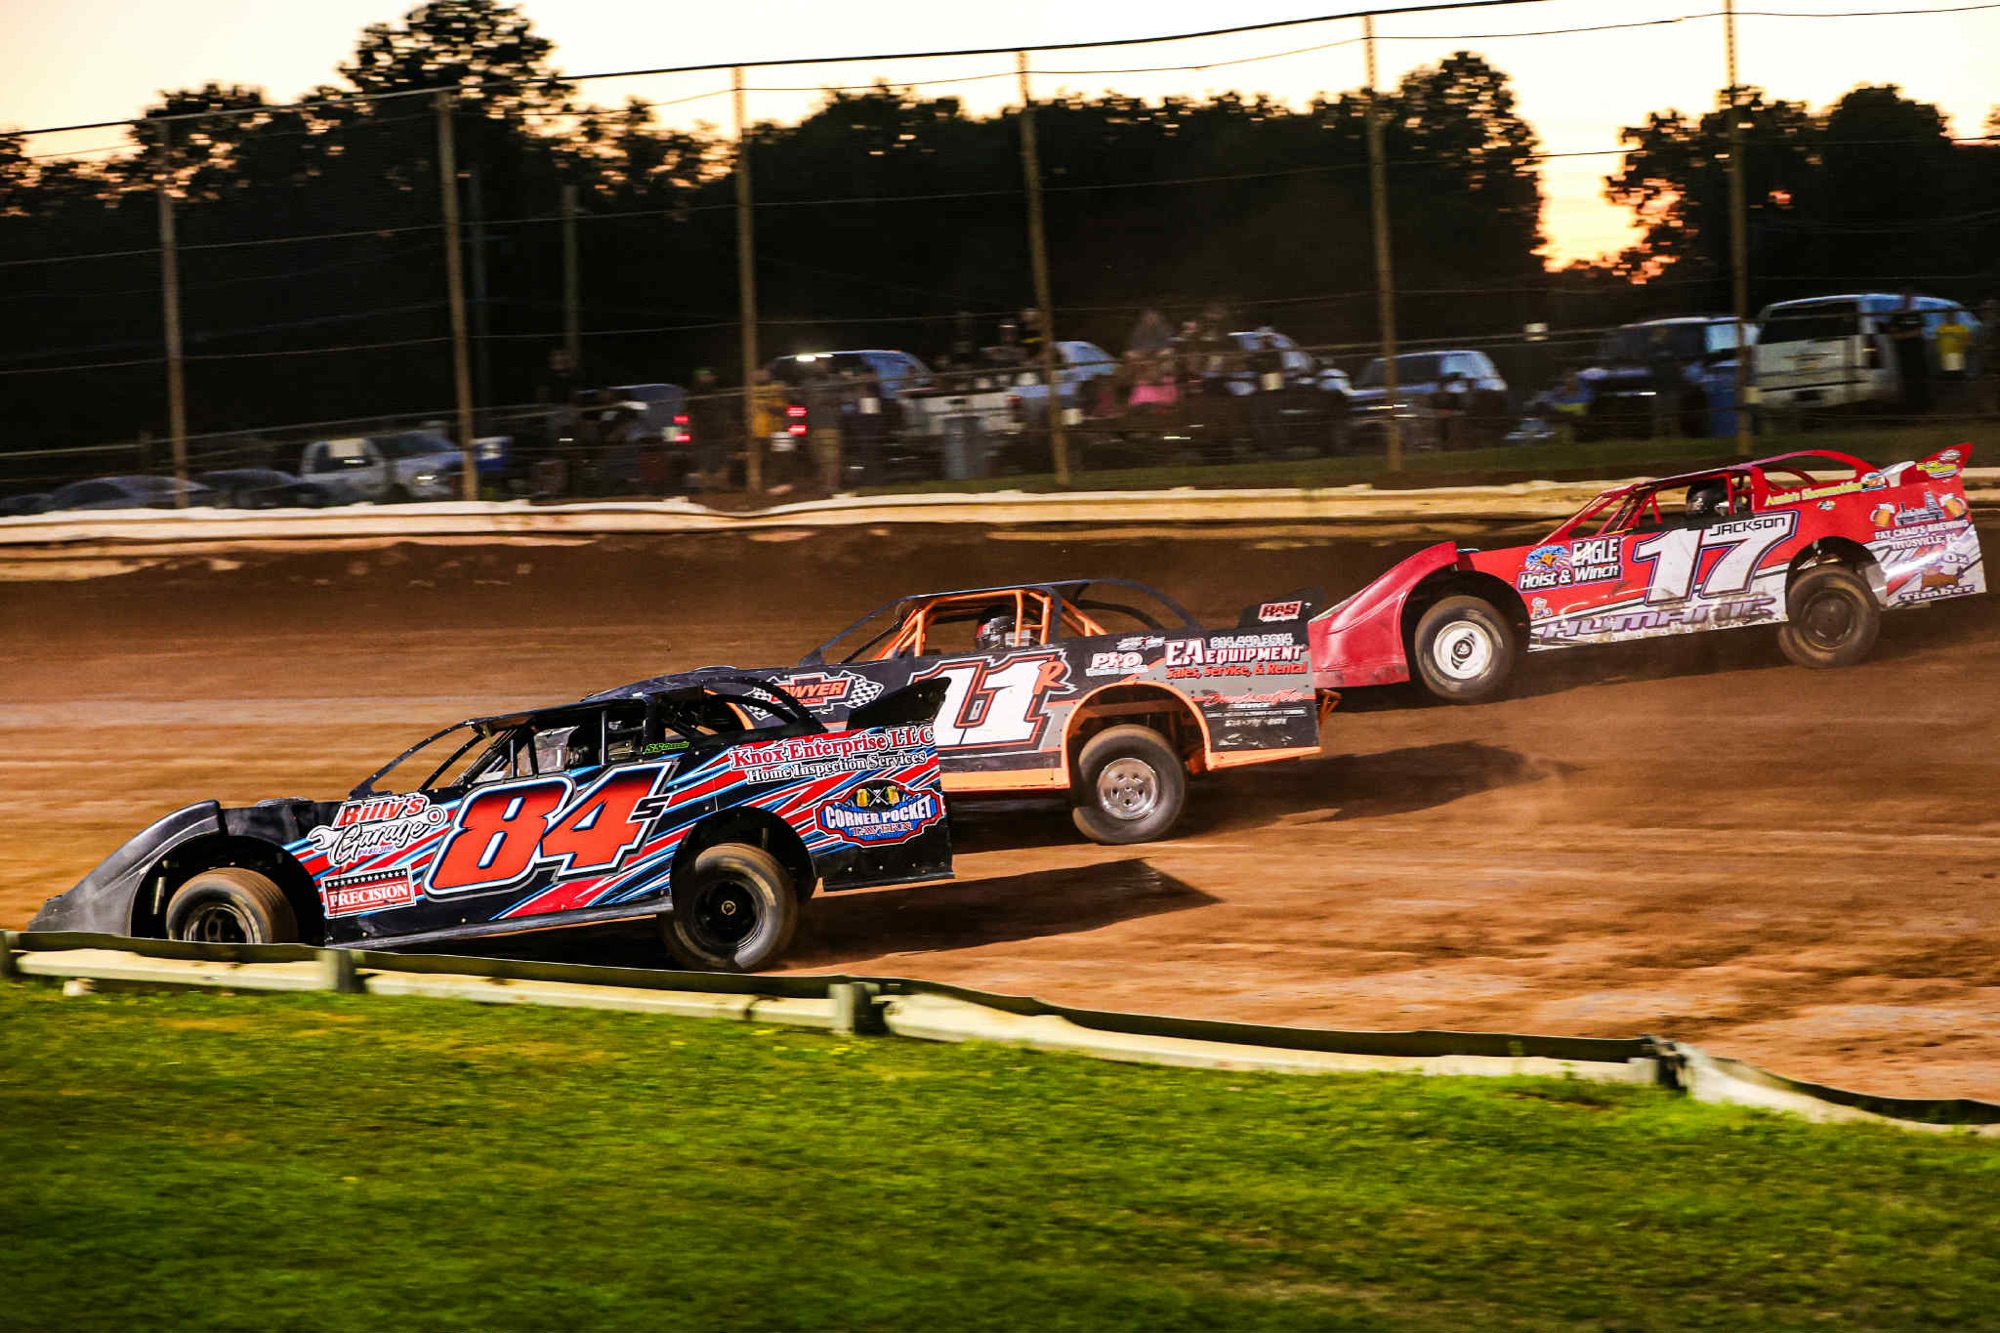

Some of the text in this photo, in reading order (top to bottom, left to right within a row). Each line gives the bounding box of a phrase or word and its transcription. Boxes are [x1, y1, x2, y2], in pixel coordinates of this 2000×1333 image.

[1709, 517, 1787, 537] JACKSON
[1571, 538, 1619, 567] EAGLE
[1635, 511, 1797, 604] 17
[1520, 565, 1619, 589] Hoist & Winch
[1899, 585, 1975, 601] Timber
[1164, 638, 1205, 667] EA
[1205, 645, 1305, 665] EQUIPMENT
[1204, 664, 1251, 677] Service,
[1253, 662, 1266, 676] &
[1267, 662, 1308, 675] Rental
[731, 726, 934, 768] Knox Enterprise LLC
[747, 751, 926, 783] Home Inspection Services
[338, 797, 424, 827] Billy's
[824, 794, 933, 829] CORNER POCKET
[333, 820, 431, 866] Garage
[424, 763, 674, 898] 84
[850, 822, 914, 836] TAVERN
[327, 883, 409, 908] PRECISION
